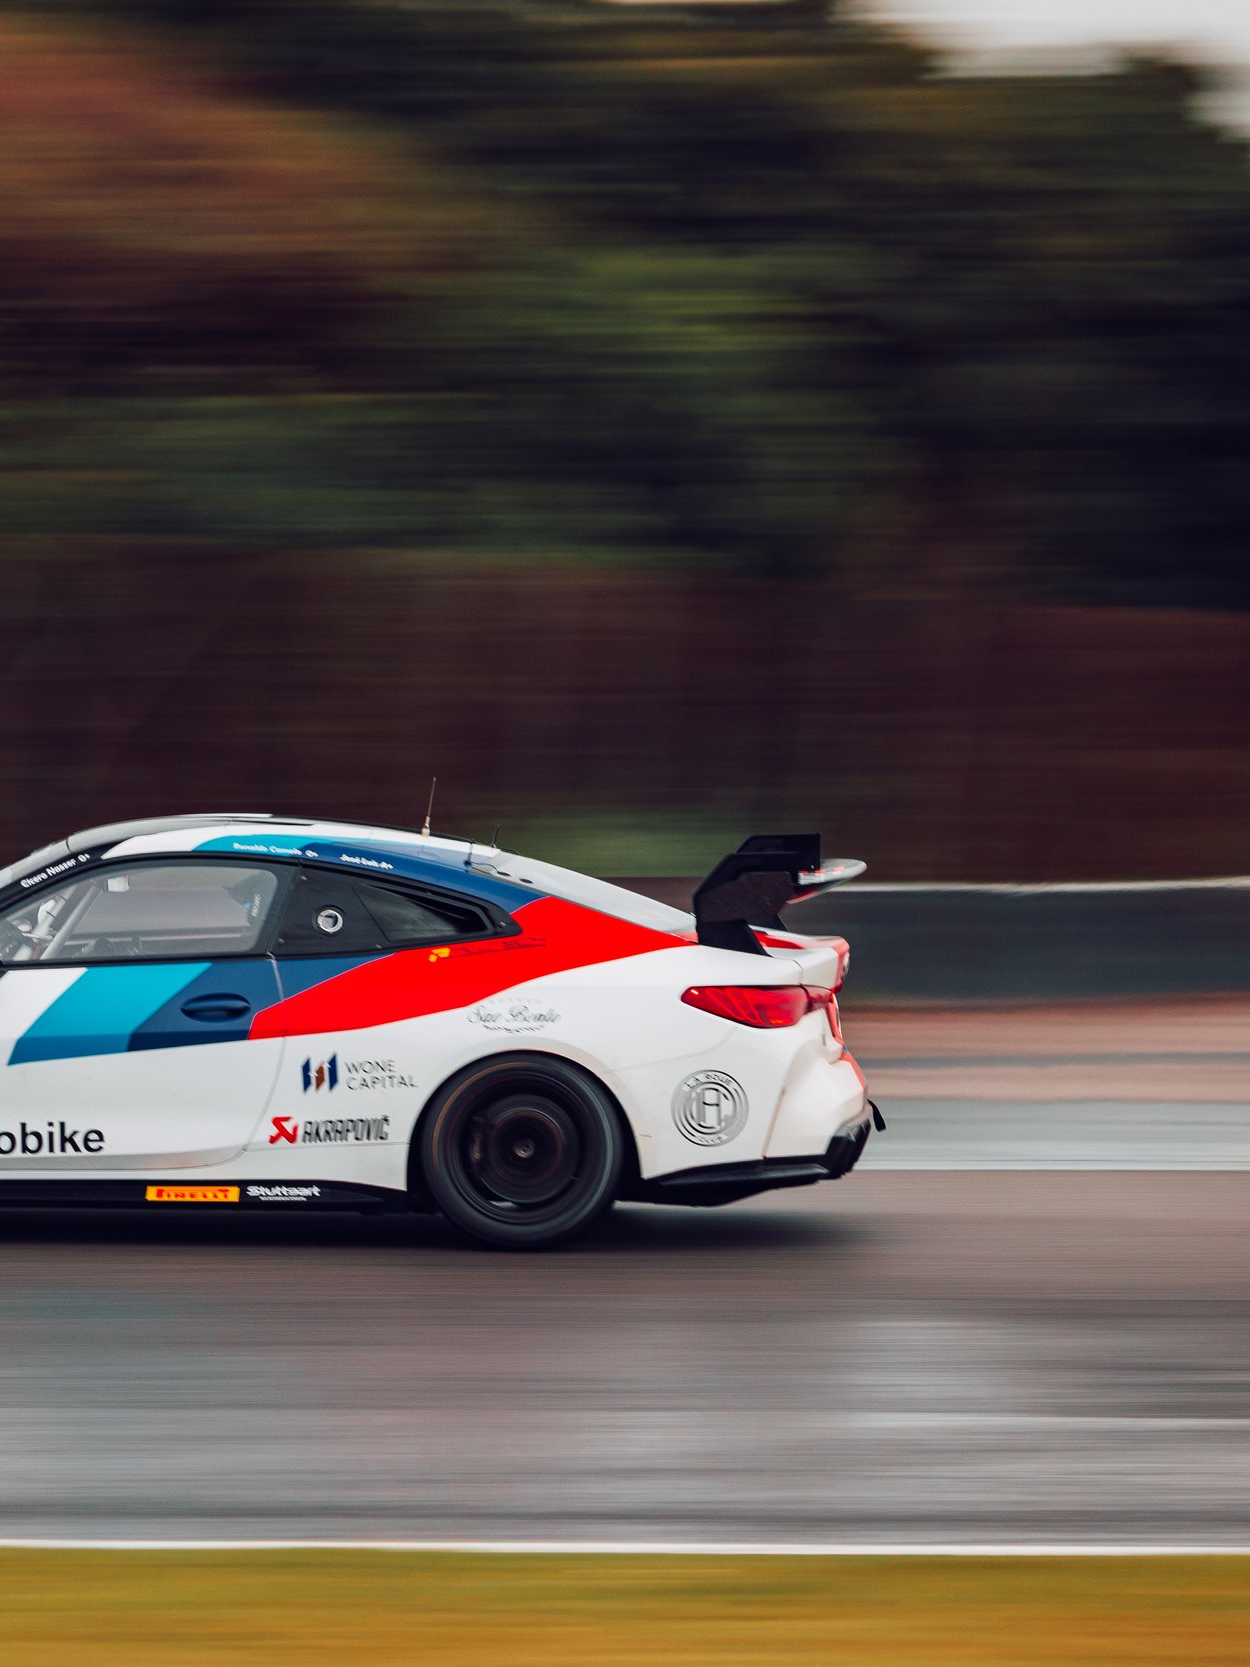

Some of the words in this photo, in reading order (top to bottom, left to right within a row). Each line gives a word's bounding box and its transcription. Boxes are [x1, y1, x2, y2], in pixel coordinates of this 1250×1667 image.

[344, 1059, 396, 1074] WONE
[347, 1074, 418, 1091] CAPITAL
[156, 1188, 230, 1199] PIRELLI
